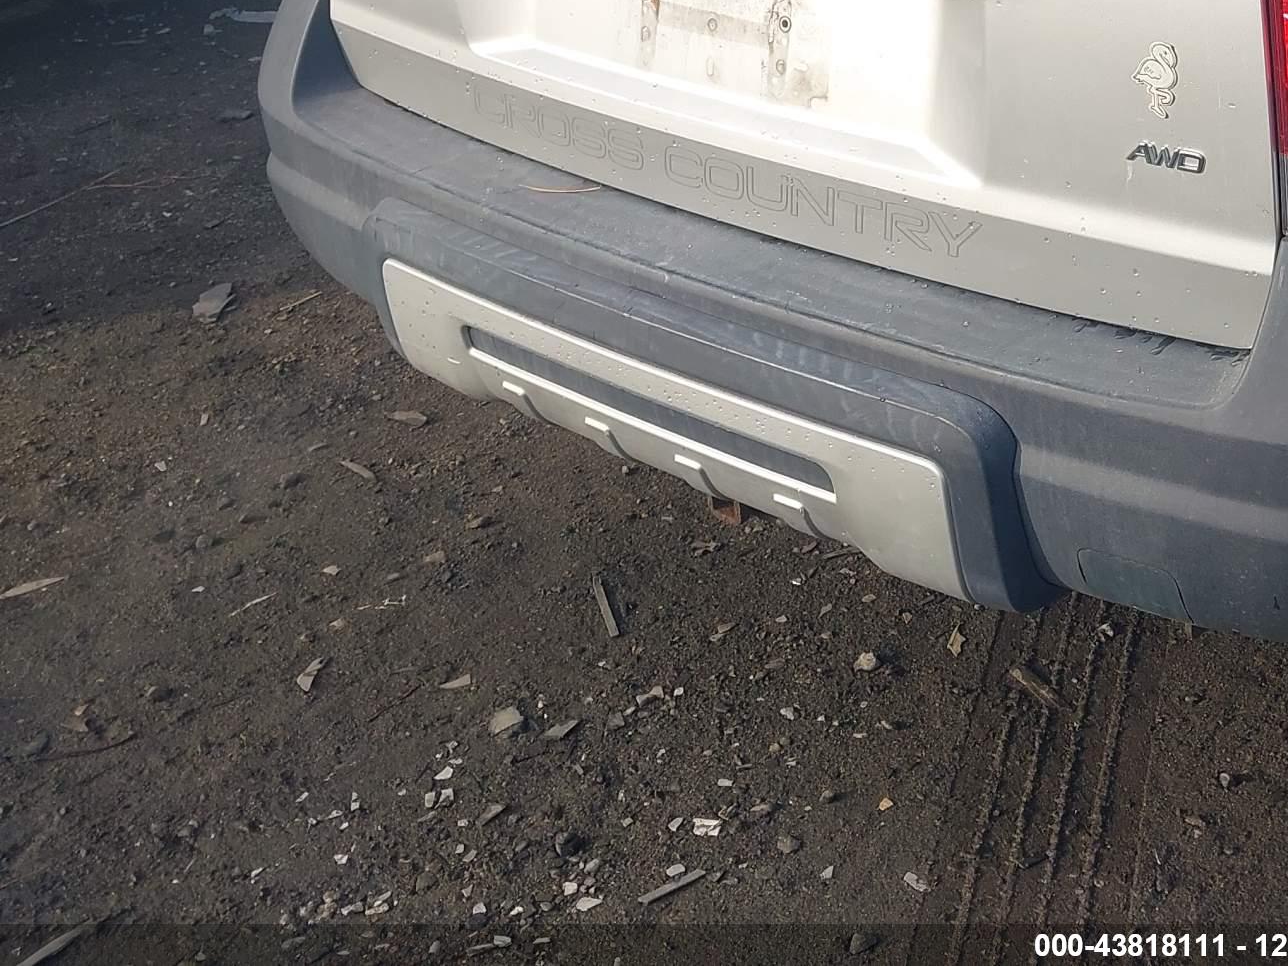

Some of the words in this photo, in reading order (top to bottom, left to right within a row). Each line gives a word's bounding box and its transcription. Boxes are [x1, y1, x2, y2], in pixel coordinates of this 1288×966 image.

[472, 82, 646, 171] CROSS
[662, 143, 984, 259] COUNTRY
[1126, 140, 1207, 174] AWD
